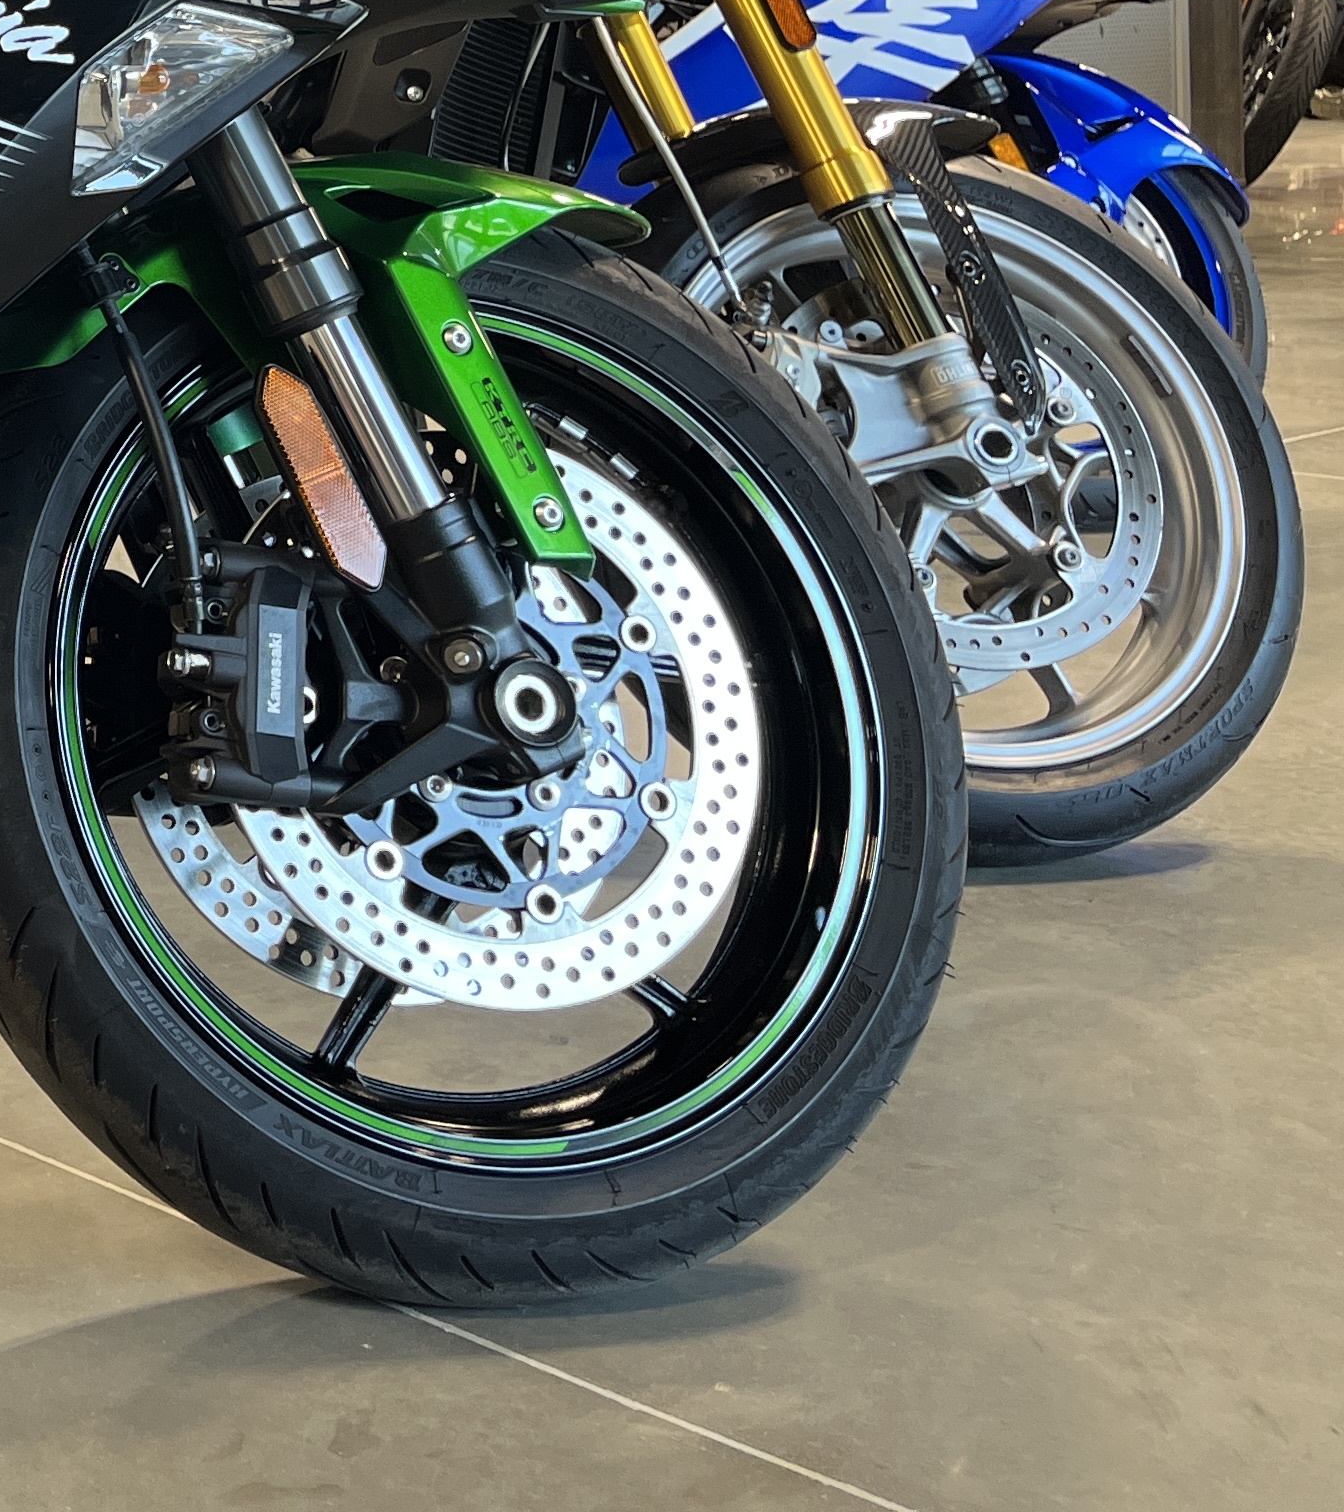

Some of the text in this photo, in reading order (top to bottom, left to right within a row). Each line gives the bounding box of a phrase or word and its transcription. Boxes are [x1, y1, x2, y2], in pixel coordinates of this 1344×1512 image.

[267, 632, 284, 714] Kawasaki
[126, 976, 248, 1100] HYPERSPORT
[756, 975, 874, 1121] BRIDGESTONE
[272, 1112, 421, 1193] BATTLAX
